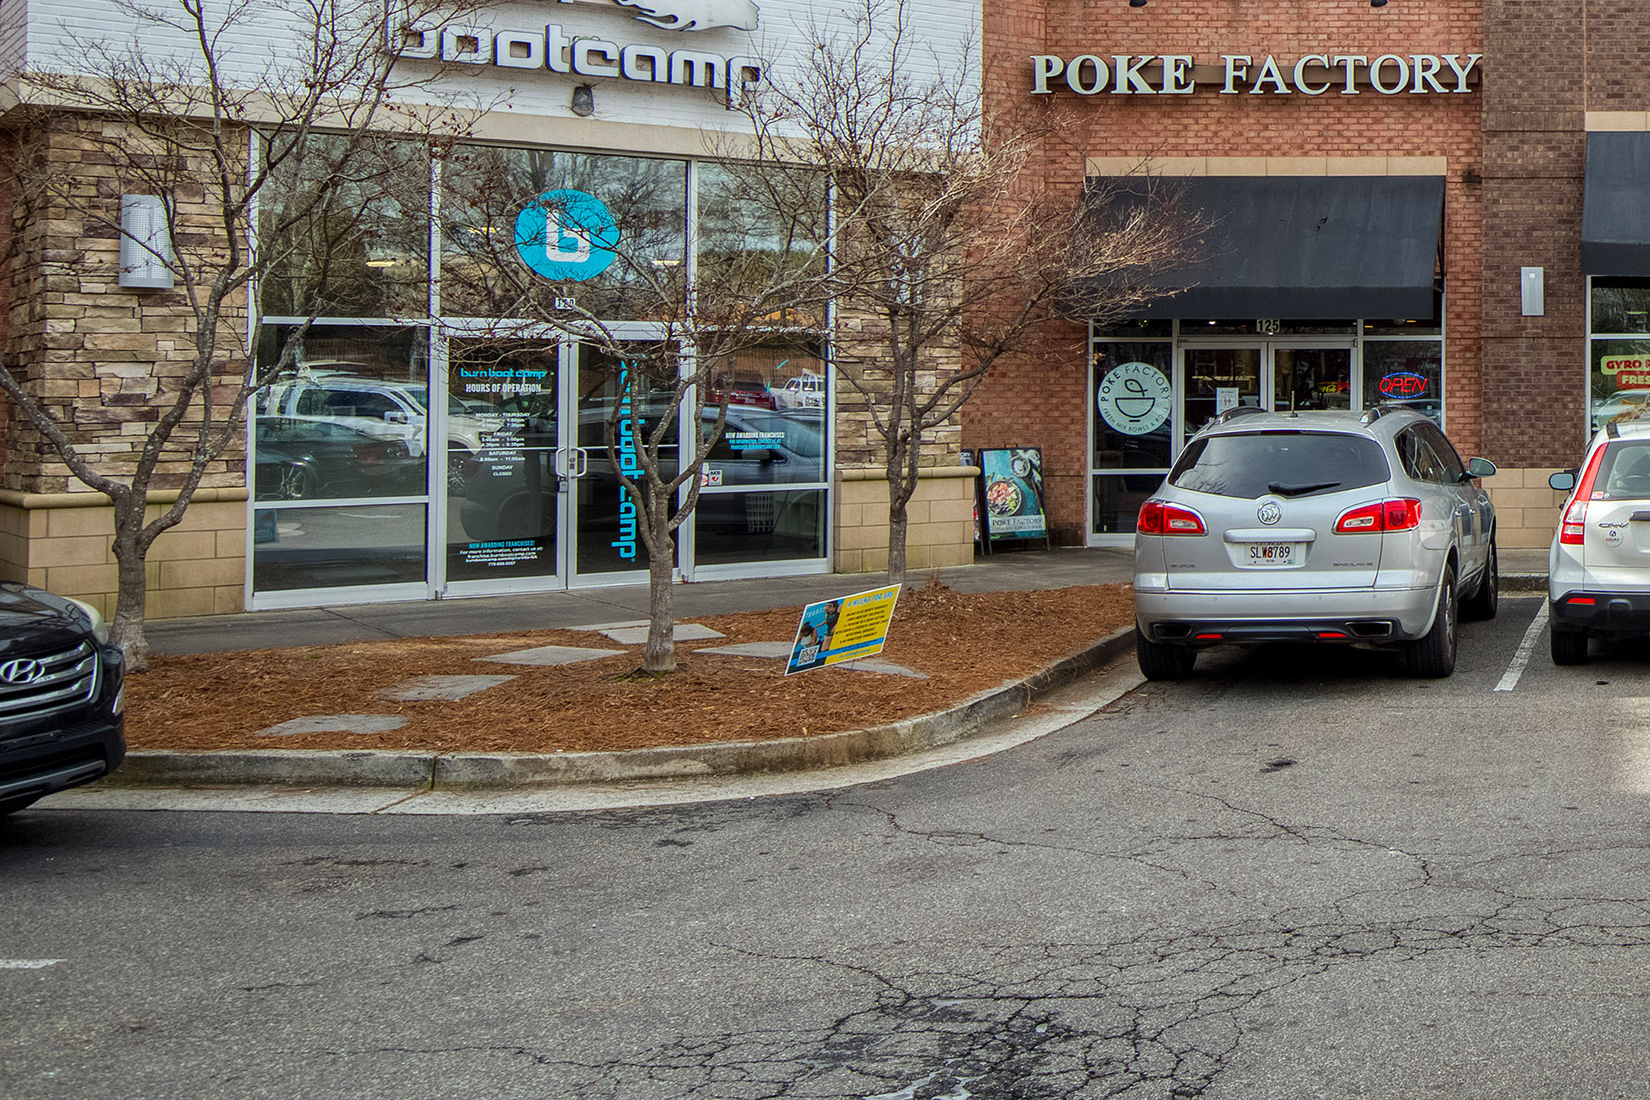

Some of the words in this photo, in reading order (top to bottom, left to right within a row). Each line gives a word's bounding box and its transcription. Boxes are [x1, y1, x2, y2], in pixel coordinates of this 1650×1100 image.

[1029, 54, 1196, 95] POKE
[1219, 53, 1483, 95] FACTORY
[1257, 319, 1280, 332] 125
[1605, 359, 1643, 370] GYRO
[460, 368, 487, 378] burn
[488, 368, 515, 378] boot
[515, 370, 548, 380] camp
[465, 383, 490, 393] HOURS
[491, 383, 502, 393] OF
[502, 383, 542, 393] OPERATION
[1100, 371, 1121, 402] POKE
[1124, 365, 1171, 401] FACTORY
[1378, 377, 1428, 393] OPEN
[1128, 424, 1150, 433] BOWLS
[1250, 546, 1291, 559] SLW8789
